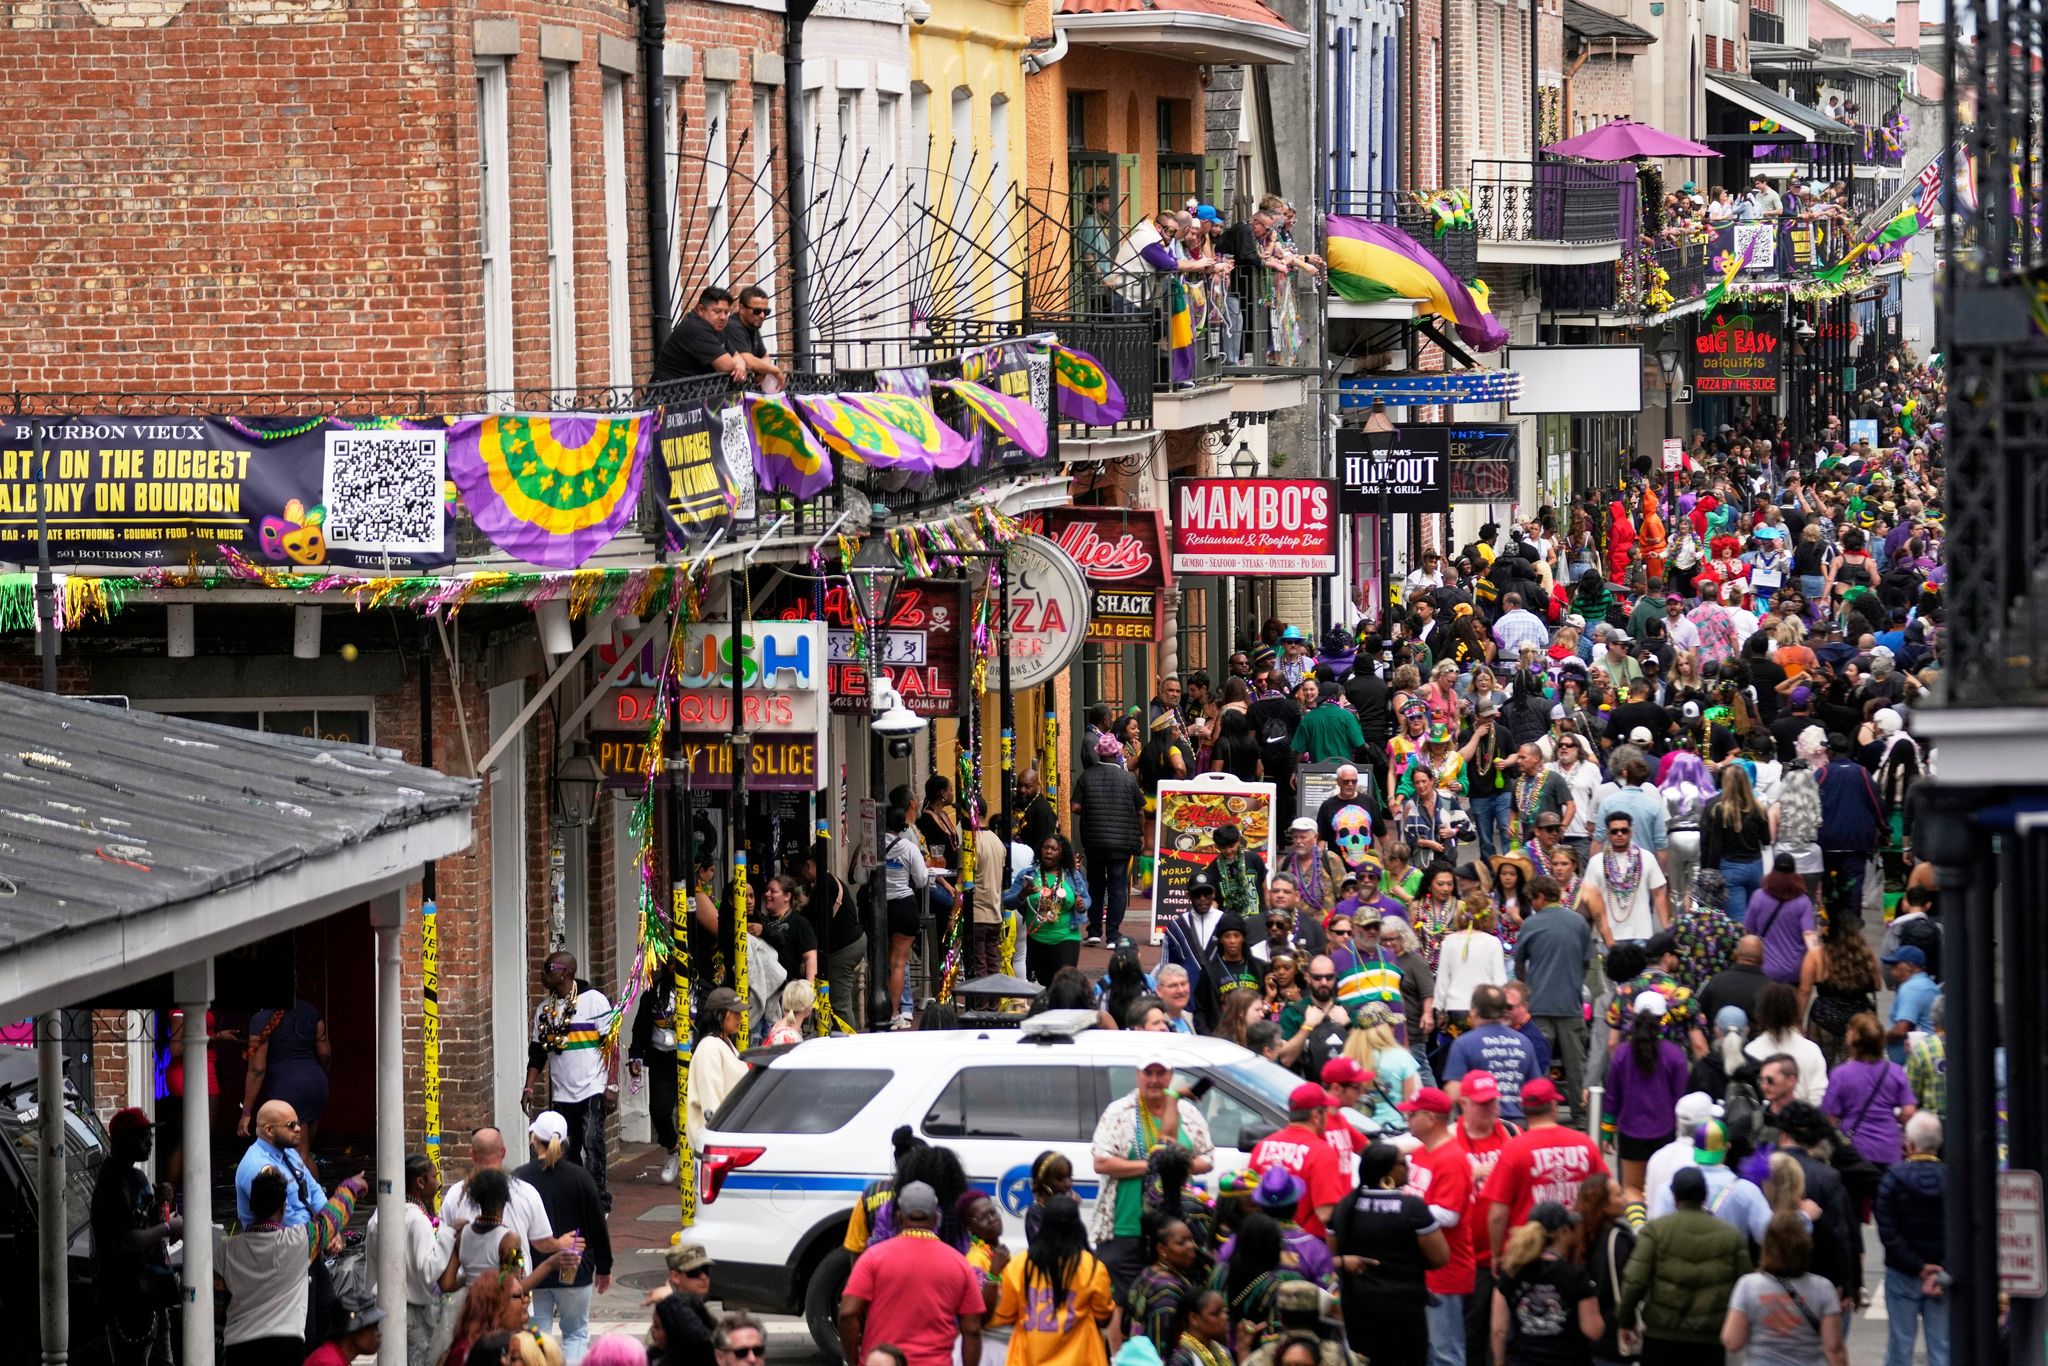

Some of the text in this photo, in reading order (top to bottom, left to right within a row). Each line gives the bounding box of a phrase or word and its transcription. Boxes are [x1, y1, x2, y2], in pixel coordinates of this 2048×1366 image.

[1696, 330, 1776, 353] BIG EASY
[1697, 379, 1775, 390] PIZZA BY THE SLICE
[134, 425, 204, 440] VIEUX
[60, 450, 89, 479] ON
[99, 449, 144, 479] THE
[152, 450, 251, 480] BIGGEST
[1361, 486, 1422, 494] BAR GRILL
[95, 482, 125, 512] ON
[134, 482, 240, 513] BOURBON
[1181, 486, 1328, 530] MAMBO'S
[1, 528, 244, 541] BAR PRATE RESTROOMS GOURMET FOOD LIVE MUSIC
[1186, 532, 1323, 549] Restaurant & Rooftop Bar
[57, 550, 164, 560] 501 BOURBON ST.
[1181, 557, 1327, 569] GUMBO SEAFOOD STEAKS OYSTERS PO BOYS
[1097, 594, 1152, 614] SHACK
[1116, 624, 1152, 637] BEER
[989, 665, 1031, 676] ORANS,
[617, 694, 793, 723] DAQURIS
[909, 699, 935, 709] COME
[706, 744, 733, 775] TH
[752, 743, 813, 775] SLICE
[1161, 866, 1192, 876] WORLD
[1168, 877, 1191, 886] FAM
[1163, 897, 1193, 905] CHICK
[1257, 1141, 1310, 1171] JESUS
[1530, 1145, 1590, 1177] JESUS
